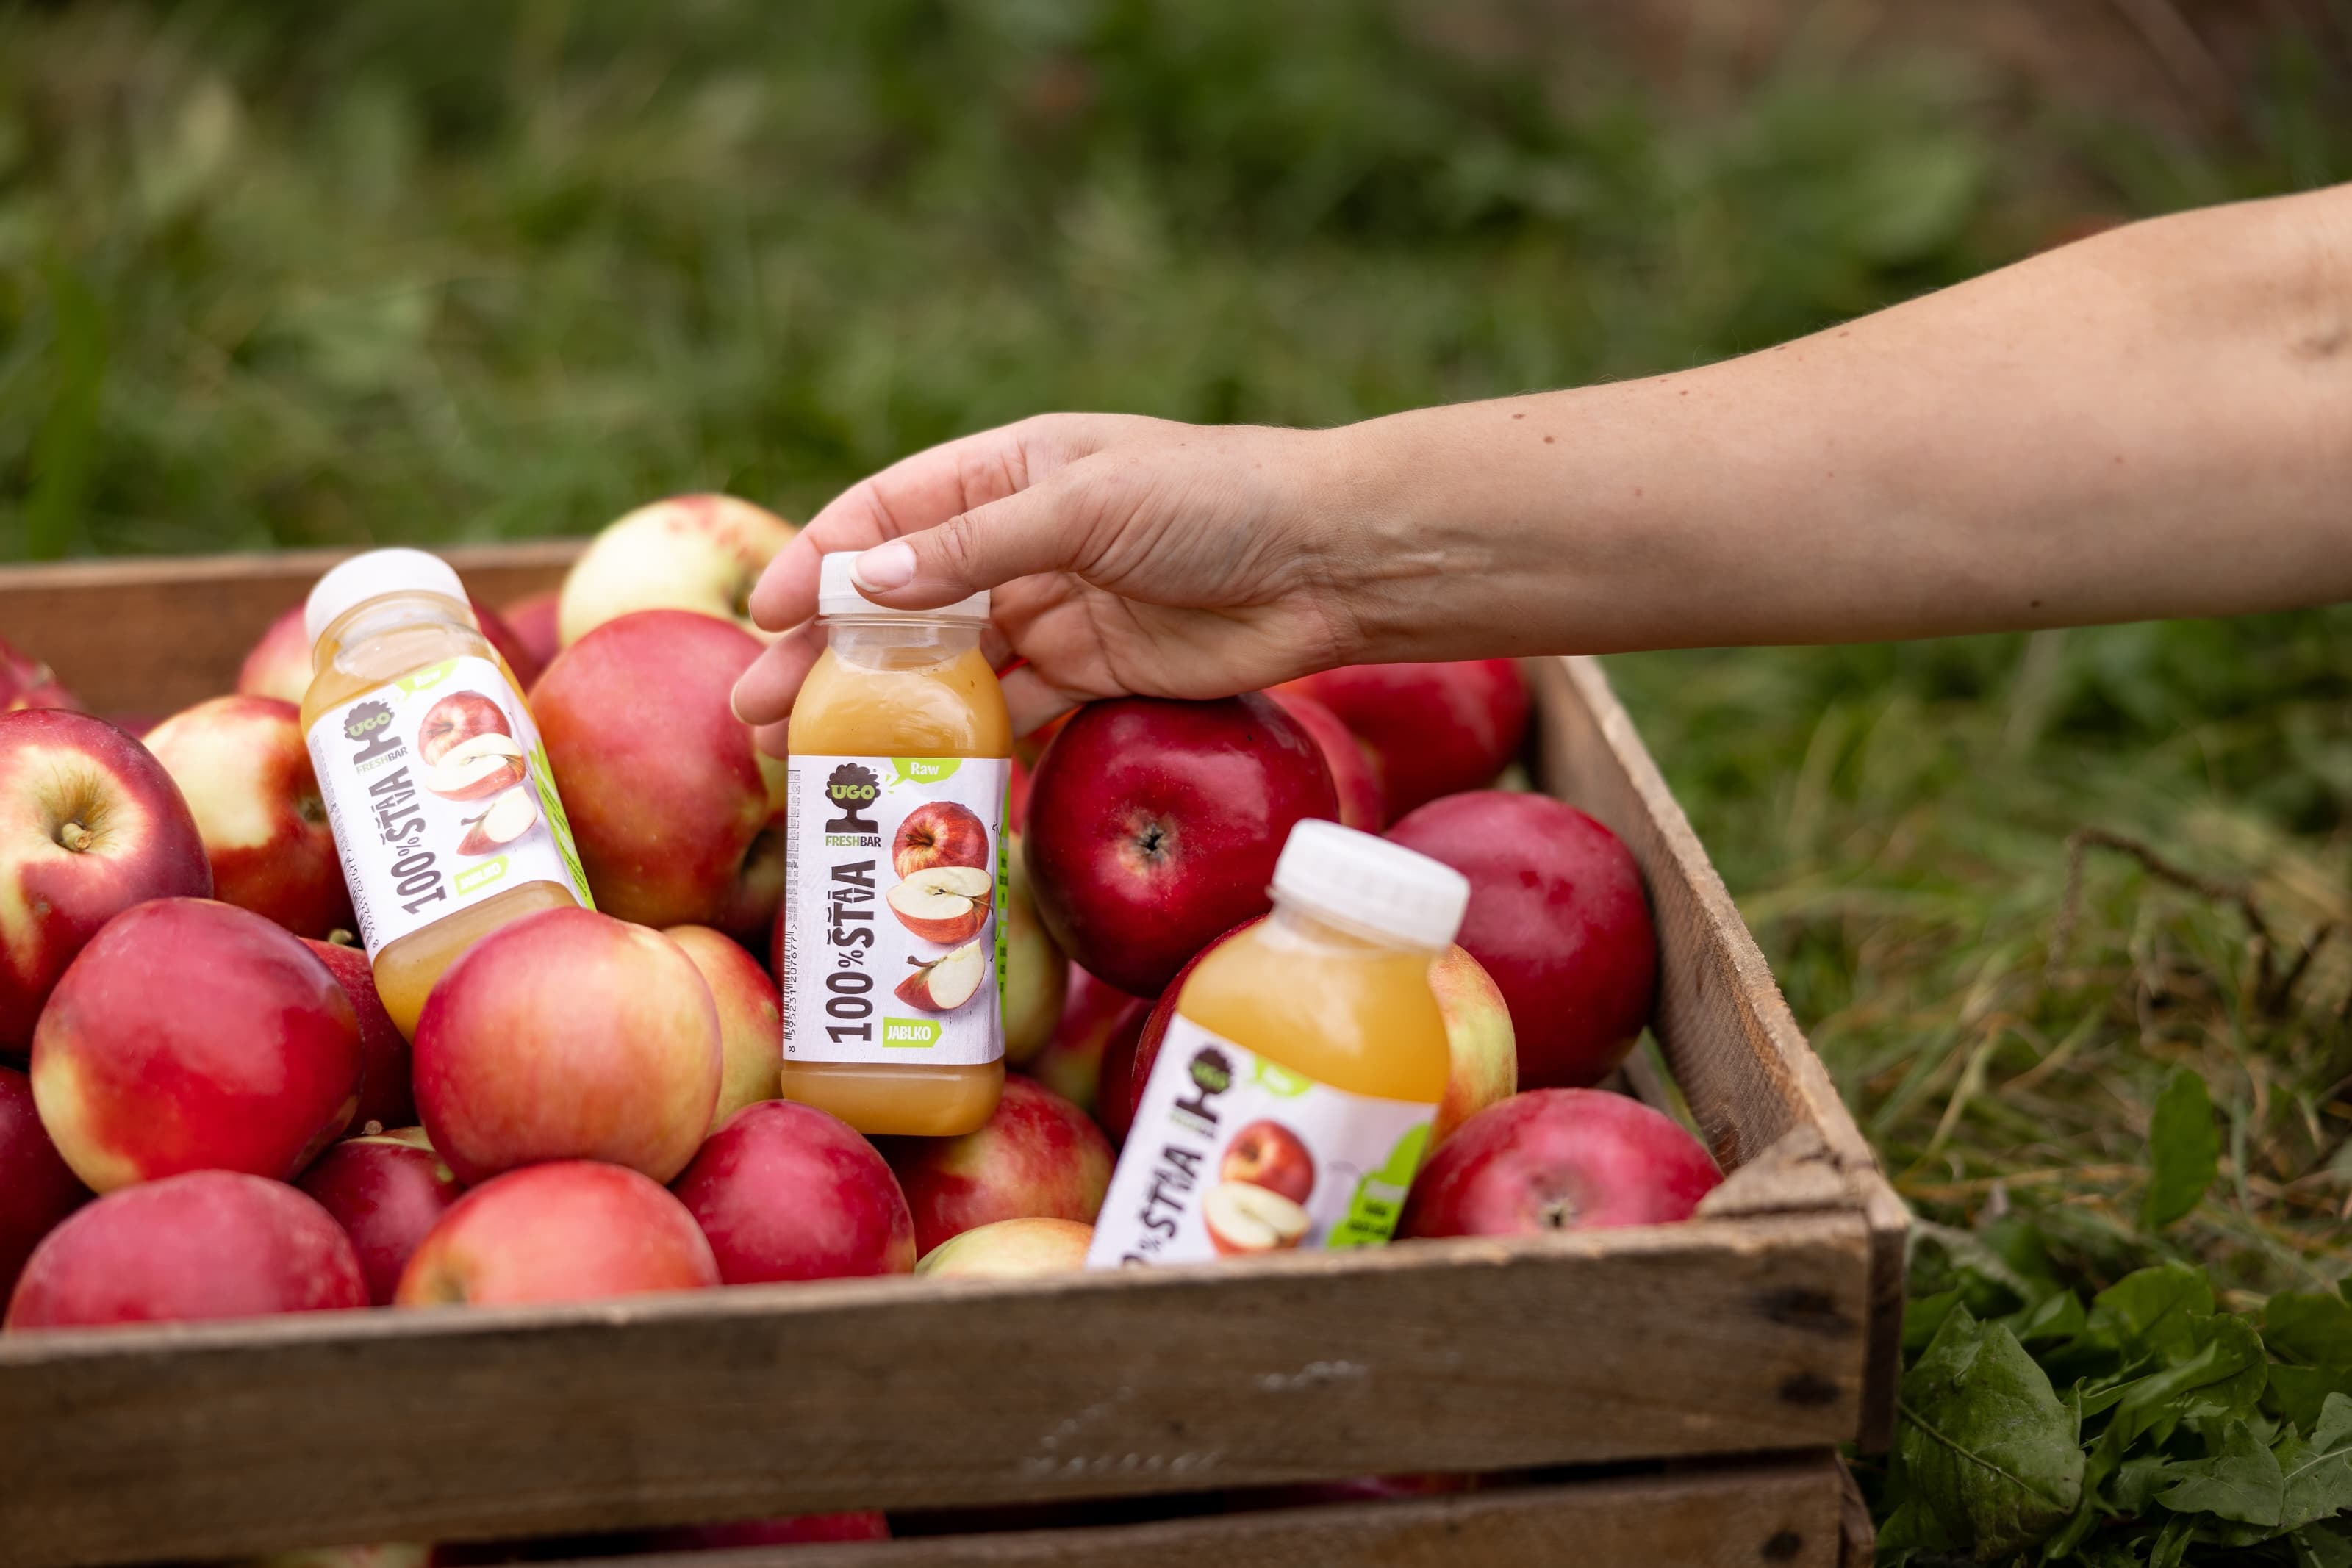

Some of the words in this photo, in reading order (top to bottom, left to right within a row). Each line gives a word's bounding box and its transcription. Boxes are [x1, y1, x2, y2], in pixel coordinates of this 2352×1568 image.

[348, 711, 391, 737] UGO
[356, 747, 409, 774] FRESHBAR
[910, 761, 941, 776] Raw
[830, 784, 876, 800] UGO
[825, 835, 881, 847] FRESHBAR
[390, 837, 448, 915] 100%
[789, 935, 798, 983] 207677
[825, 949, 874, 1043] 100%
[788, 990, 797, 1036] 595231
[886, 1025, 932, 1041] JABLKO
